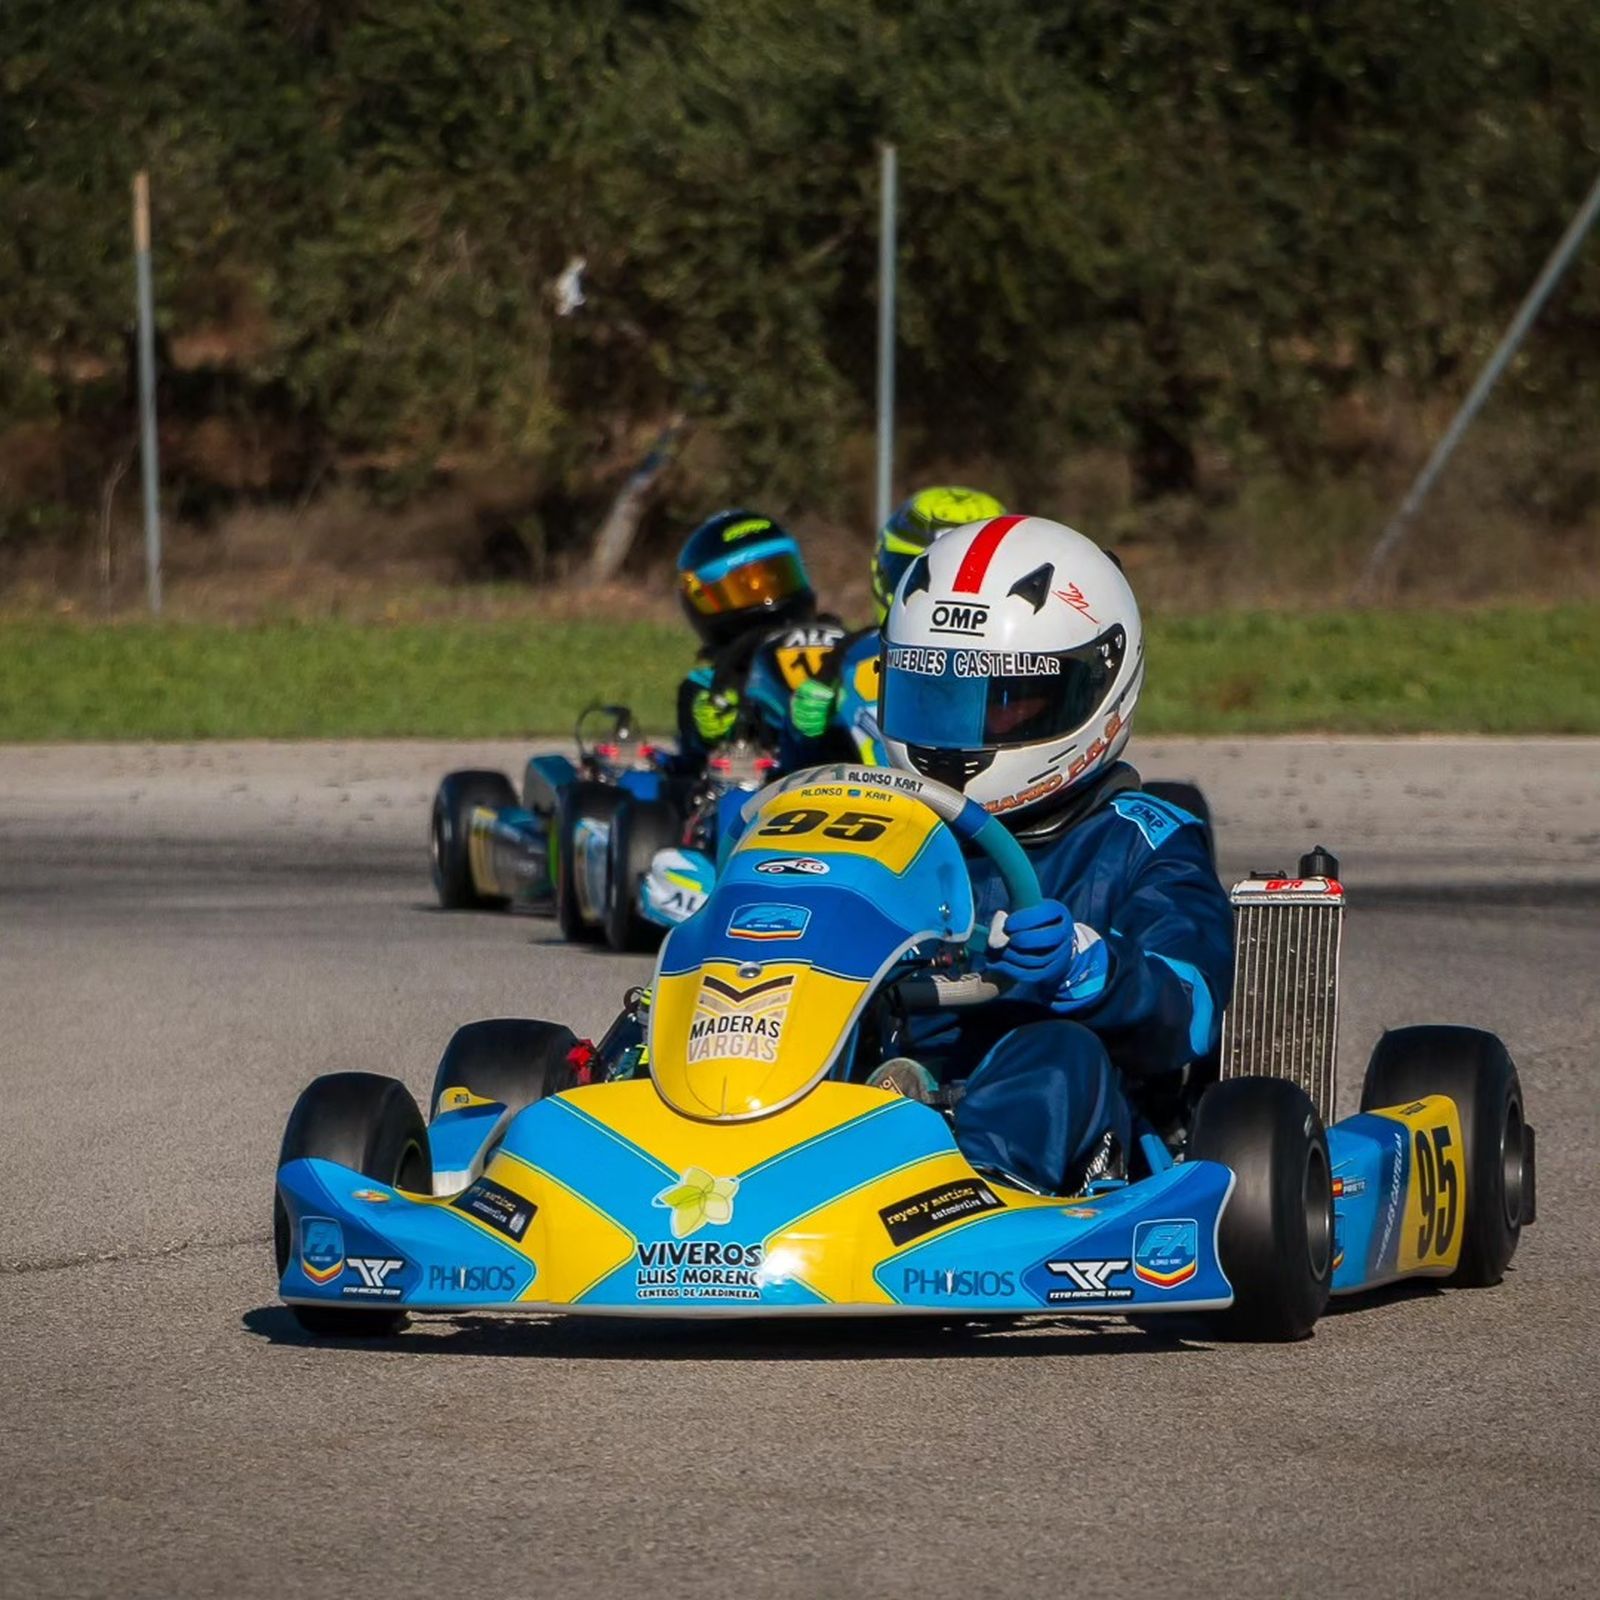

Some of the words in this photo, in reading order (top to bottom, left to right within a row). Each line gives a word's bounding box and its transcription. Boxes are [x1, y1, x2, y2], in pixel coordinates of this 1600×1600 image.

[931, 606, 988, 630] OMP
[953, 650, 1060, 677] CASTELLAR
[801, 787, 842, 798] ALONSO
[865, 790, 894, 802] KART
[848, 771, 892, 784] ALONSO
[894, 778, 924, 793] KART
[758, 809, 895, 842] 95
[689, 1015, 781, 1041] MADERAS
[688, 1035, 778, 1062] VARGAS
[1415, 1125, 1458, 1260] 95
[886, 1205, 920, 1225] reyes
[920, 1201, 930, 1213] y
[637, 1241, 763, 1267] VIVEROS
[637, 1269, 677, 1285] LUIS
[637, 1287, 680, 1299] CENTROS
[683, 1288, 696, 1298] DE
[698, 1287, 761, 1299] JARDINERIA
